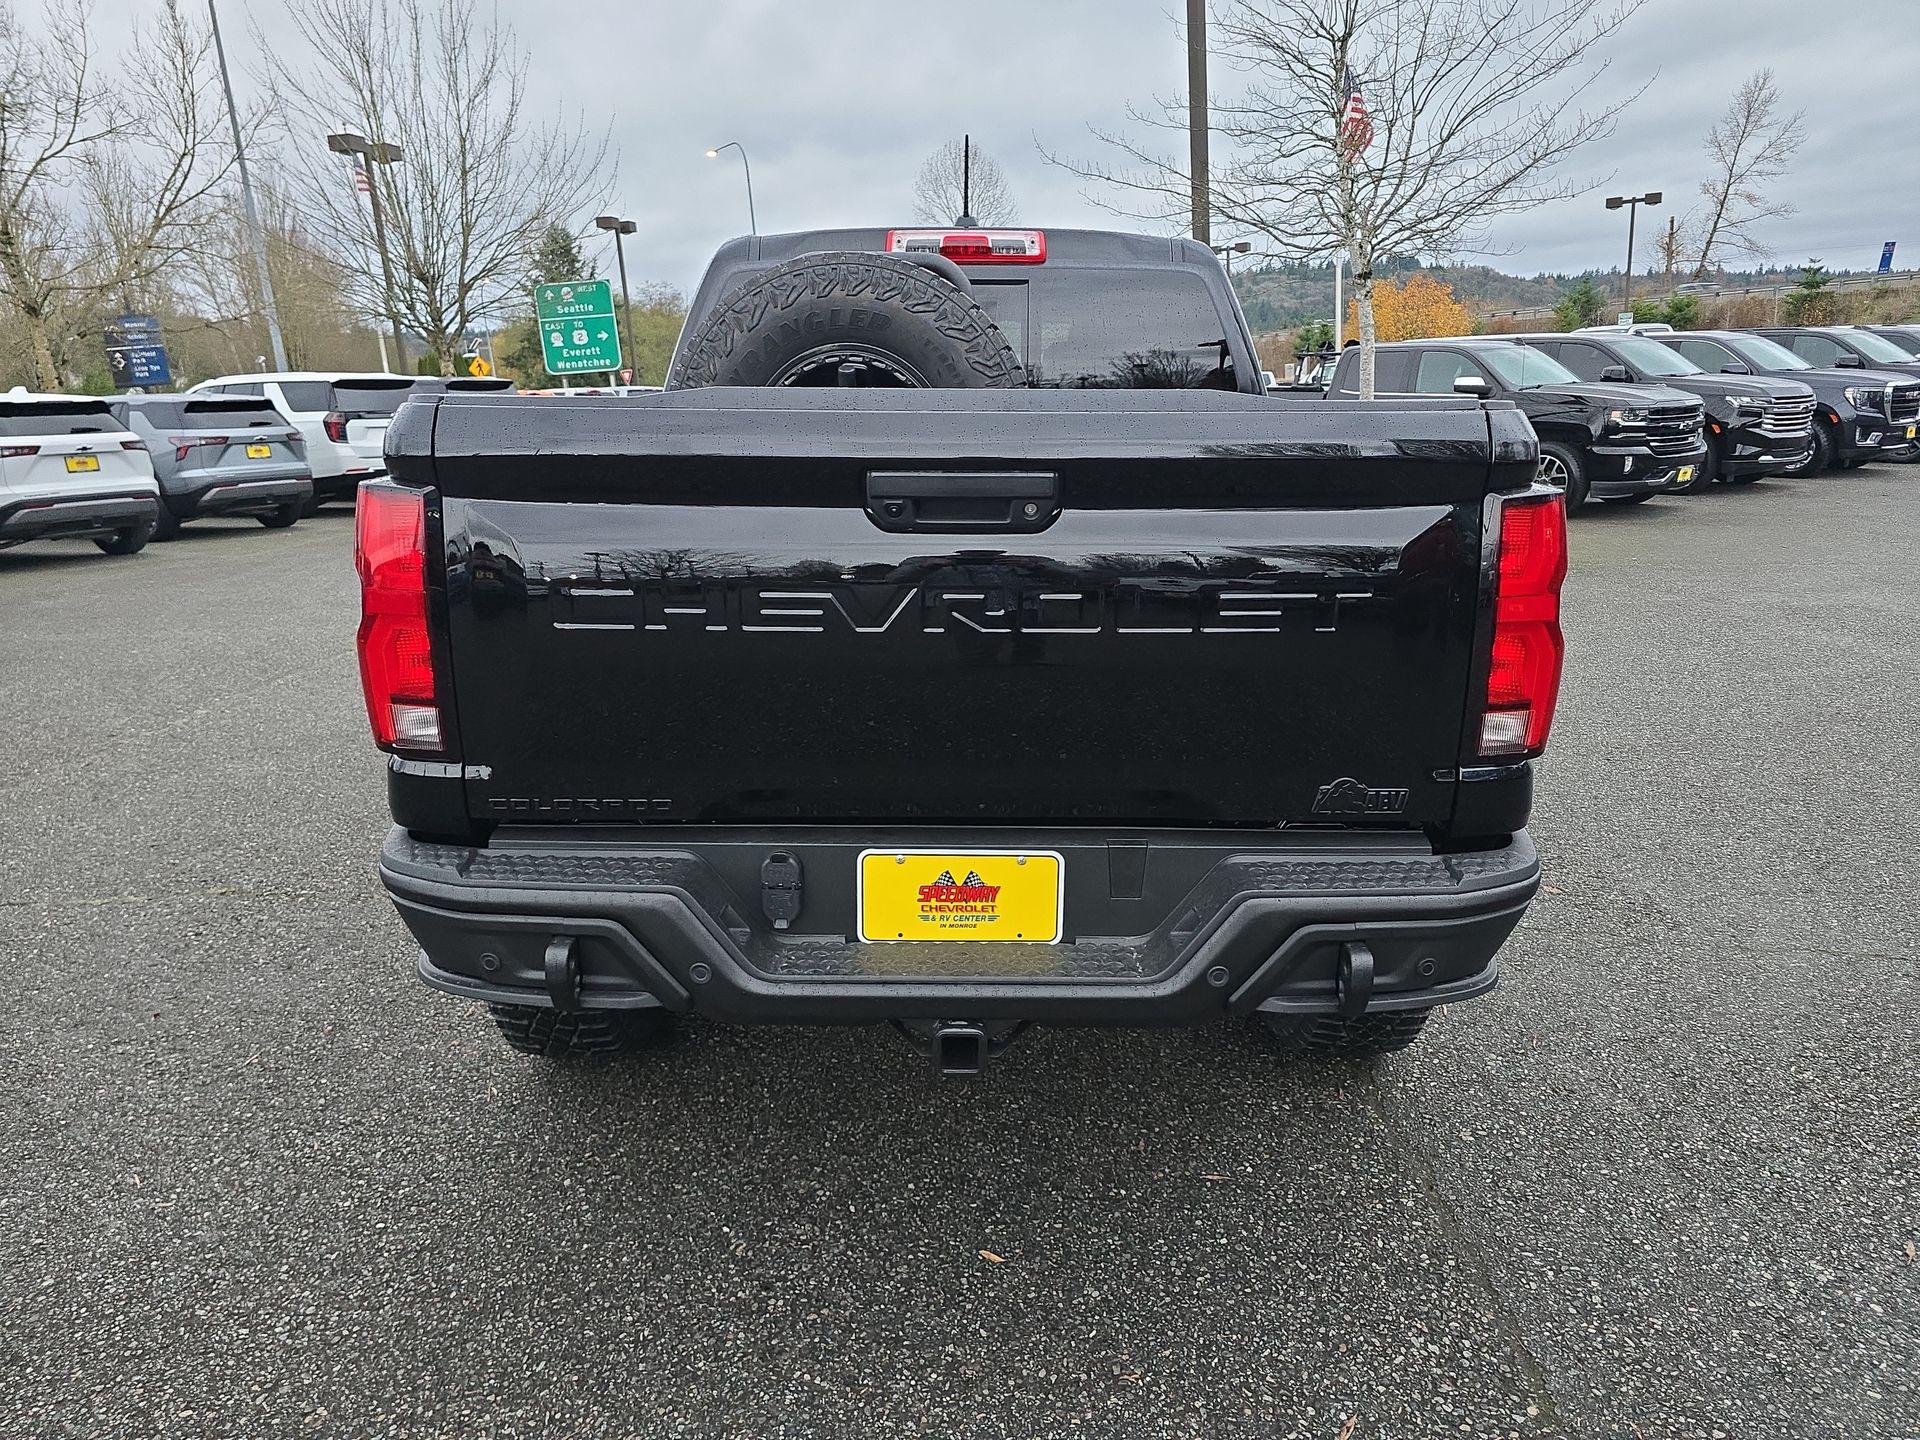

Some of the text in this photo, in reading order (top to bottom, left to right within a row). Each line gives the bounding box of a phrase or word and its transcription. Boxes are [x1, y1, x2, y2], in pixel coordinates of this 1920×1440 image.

[557, 304, 594, 313] Seattle
[545, 322, 565, 331] EAST
[577, 332, 584, 342] 2
[562, 346, 601, 357] Everett
[557, 359, 611, 368] Wenatchee
[552, 586, 1374, 633] CHEVROLET
[488, 798, 673, 812] COLORADO
[917, 885, 1001, 902] SPEEDWAY
[921, 904, 998, 913] CHEVROLET
[931, 914, 987, 922] & RV CENTER
